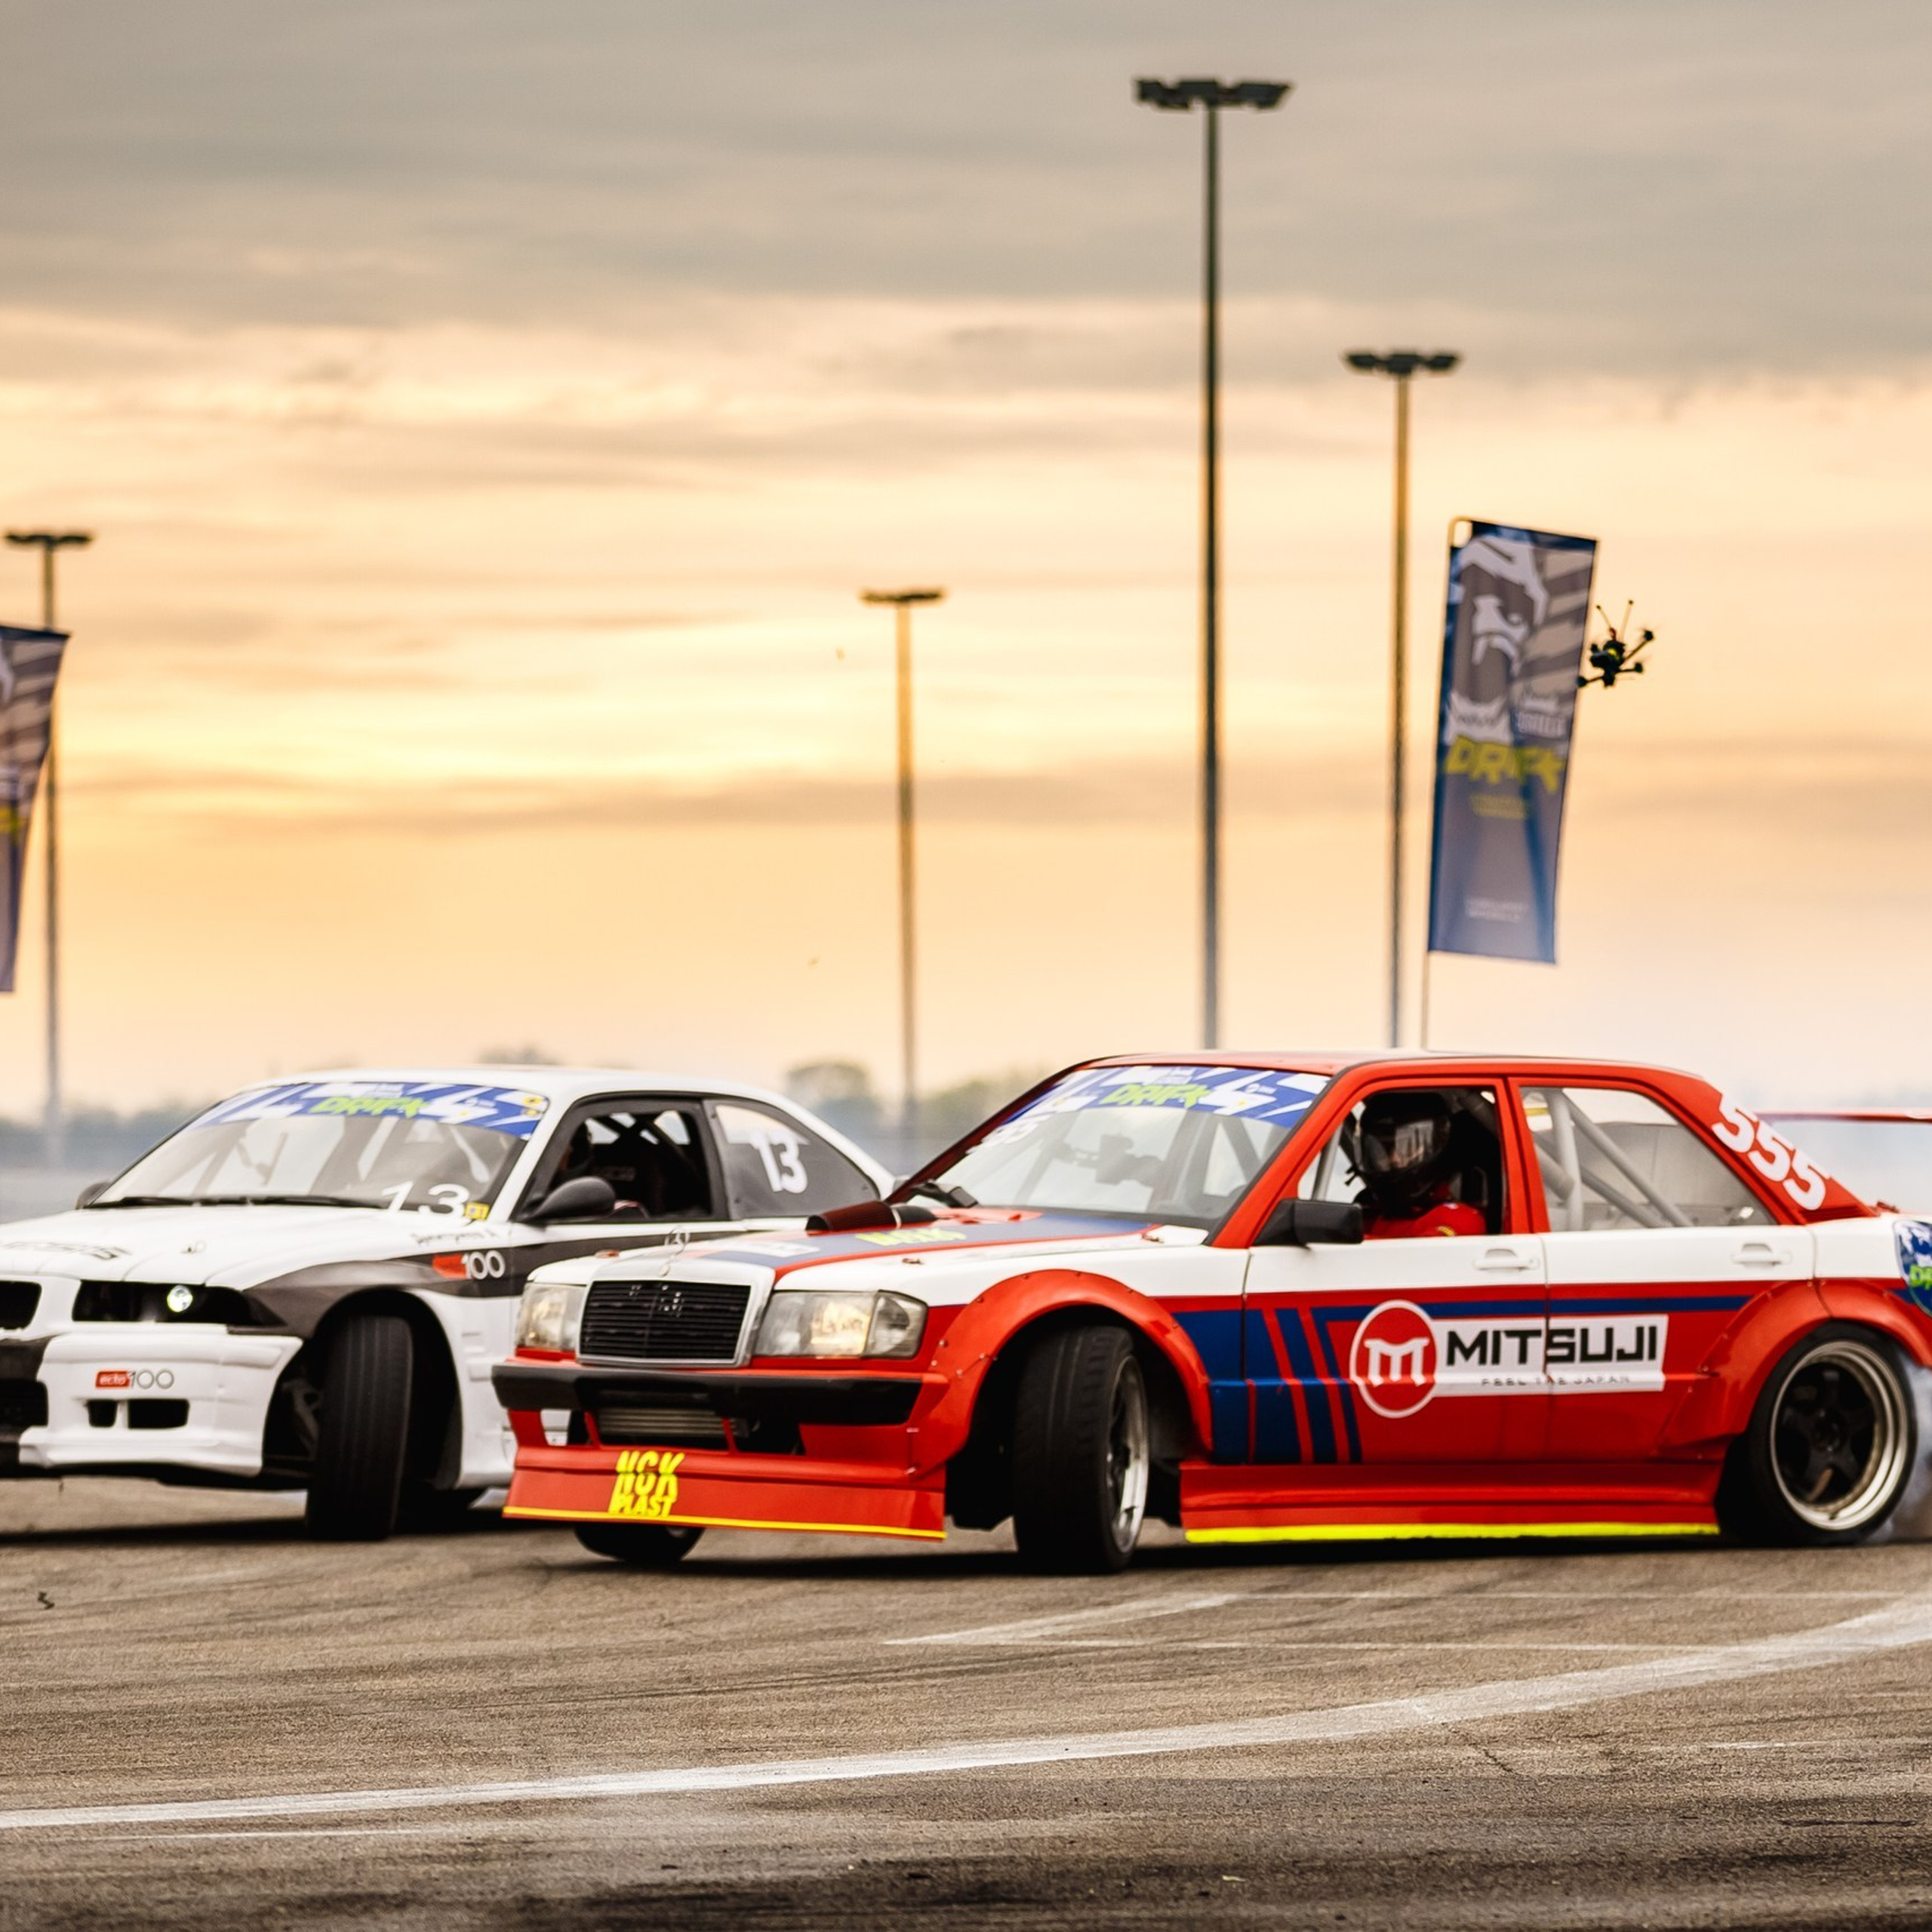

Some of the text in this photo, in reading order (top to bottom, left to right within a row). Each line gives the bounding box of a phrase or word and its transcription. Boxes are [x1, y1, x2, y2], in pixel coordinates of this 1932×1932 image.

[749, 1131, 808, 1194] 13
[1711, 1092, 1832, 1211] 555
[461, 1250, 506, 1281] 100
[1446, 1325, 1658, 1367] MITSUJI
